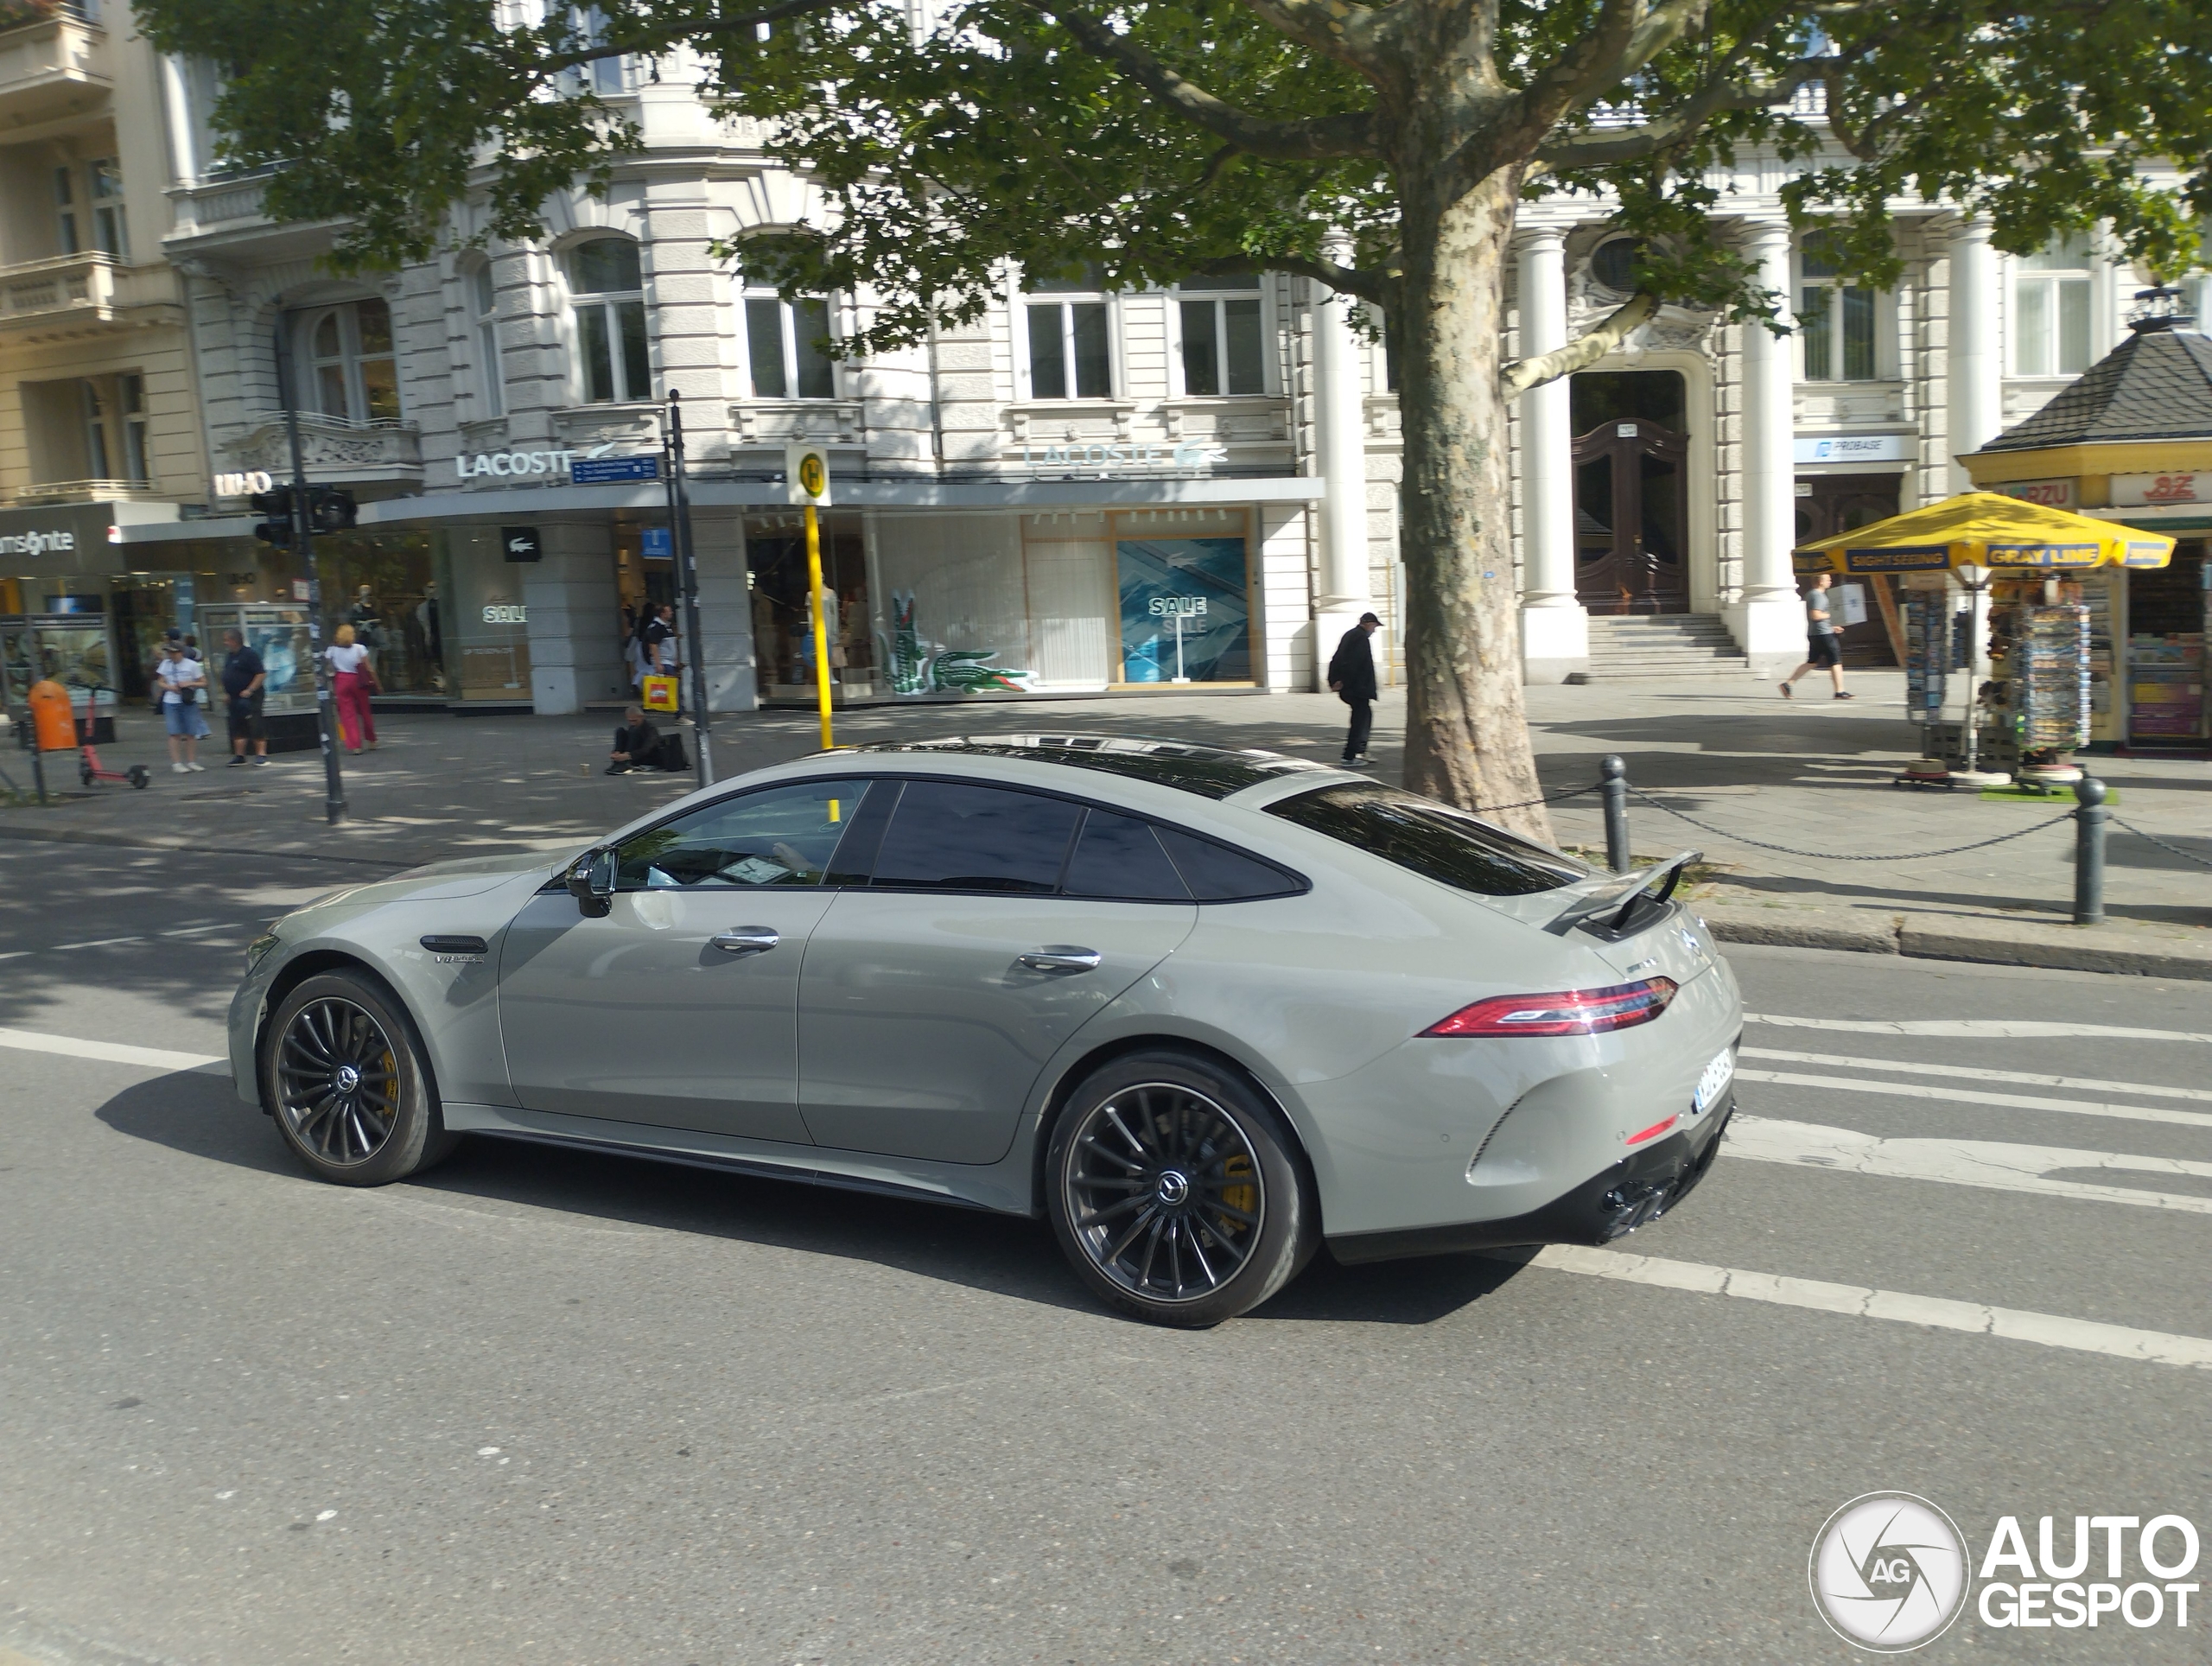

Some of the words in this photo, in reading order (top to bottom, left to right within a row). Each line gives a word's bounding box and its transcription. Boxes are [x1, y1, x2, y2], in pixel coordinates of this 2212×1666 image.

[1024, 443, 1163, 467] LACOSTE
[807, 463, 820, 488] H
[1997, 484, 2069, 506] RZU
[0, 530, 74, 556] msonite
[1990, 549, 2045, 563] GRAY
[2050, 548, 2098, 563] LINE
[1148, 596, 1207, 615] SALE
